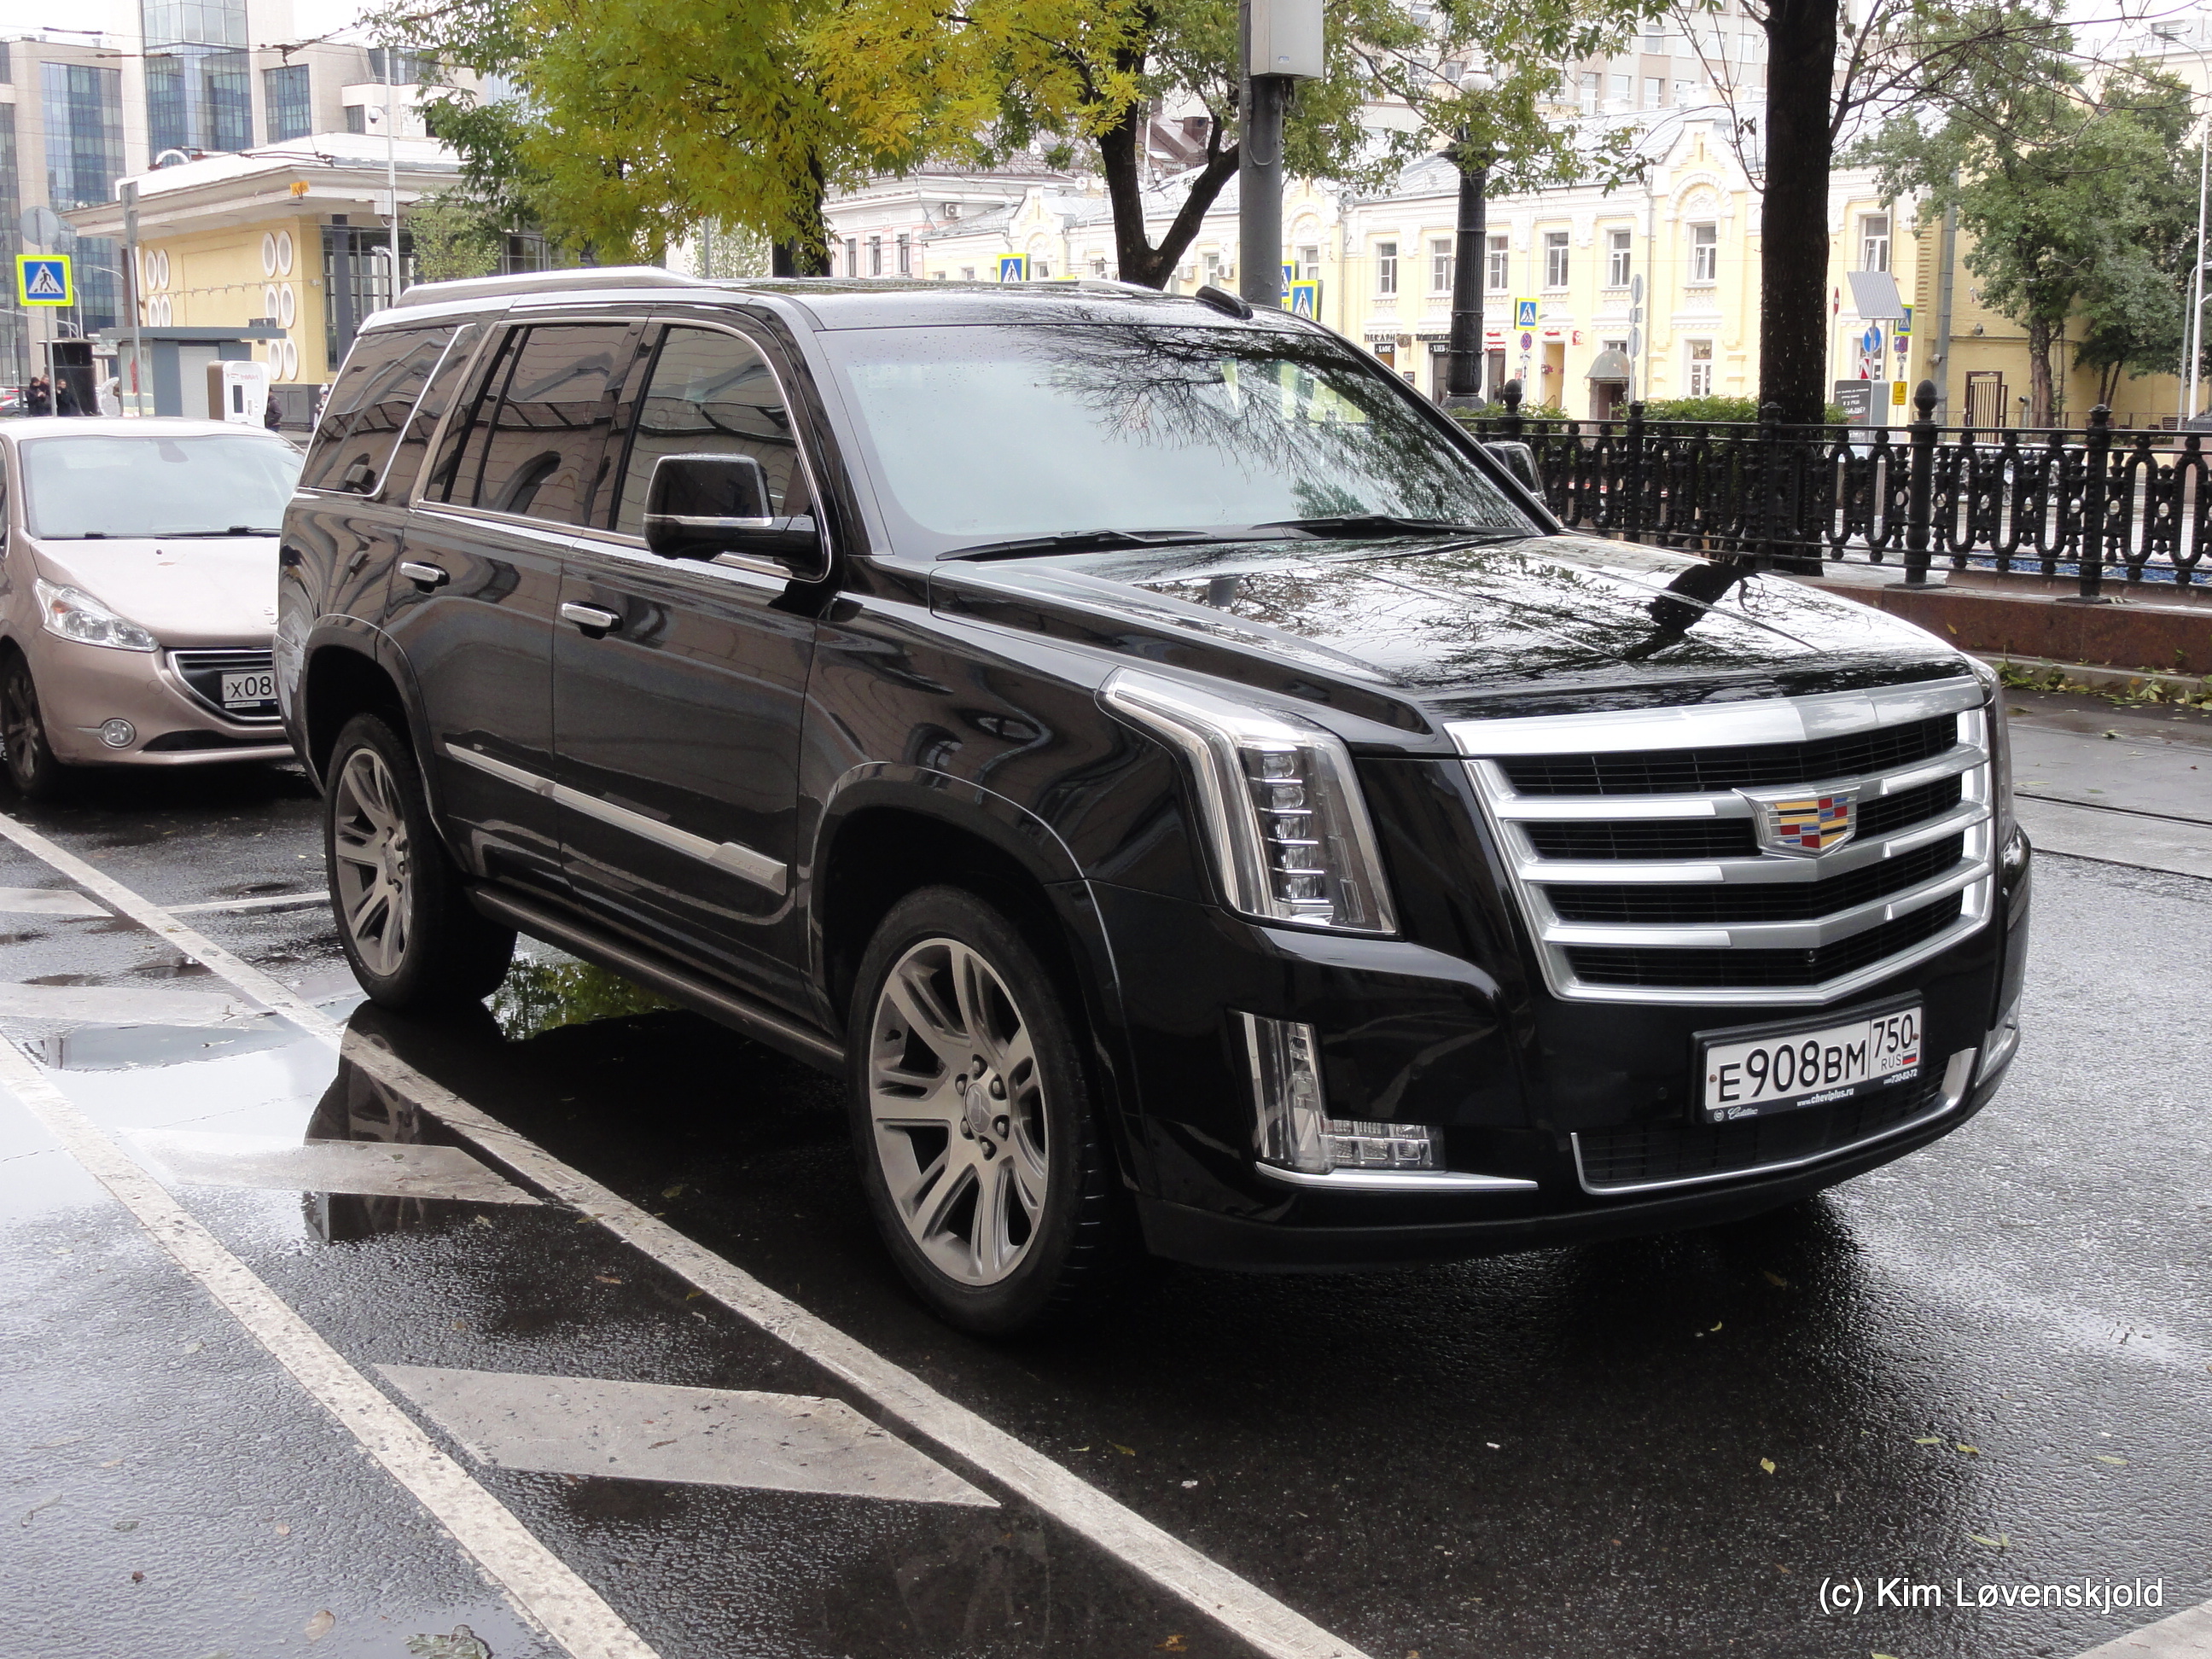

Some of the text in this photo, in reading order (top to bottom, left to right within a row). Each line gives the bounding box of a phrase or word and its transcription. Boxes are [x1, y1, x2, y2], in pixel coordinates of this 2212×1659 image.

[1365, 334, 1397, 342] ПЕКАРН
[230, 675, 276, 698] Х08
[1719, 1013, 1914, 1103] Е908ВМ 750
[1880, 1055, 1902, 1072] RUS
